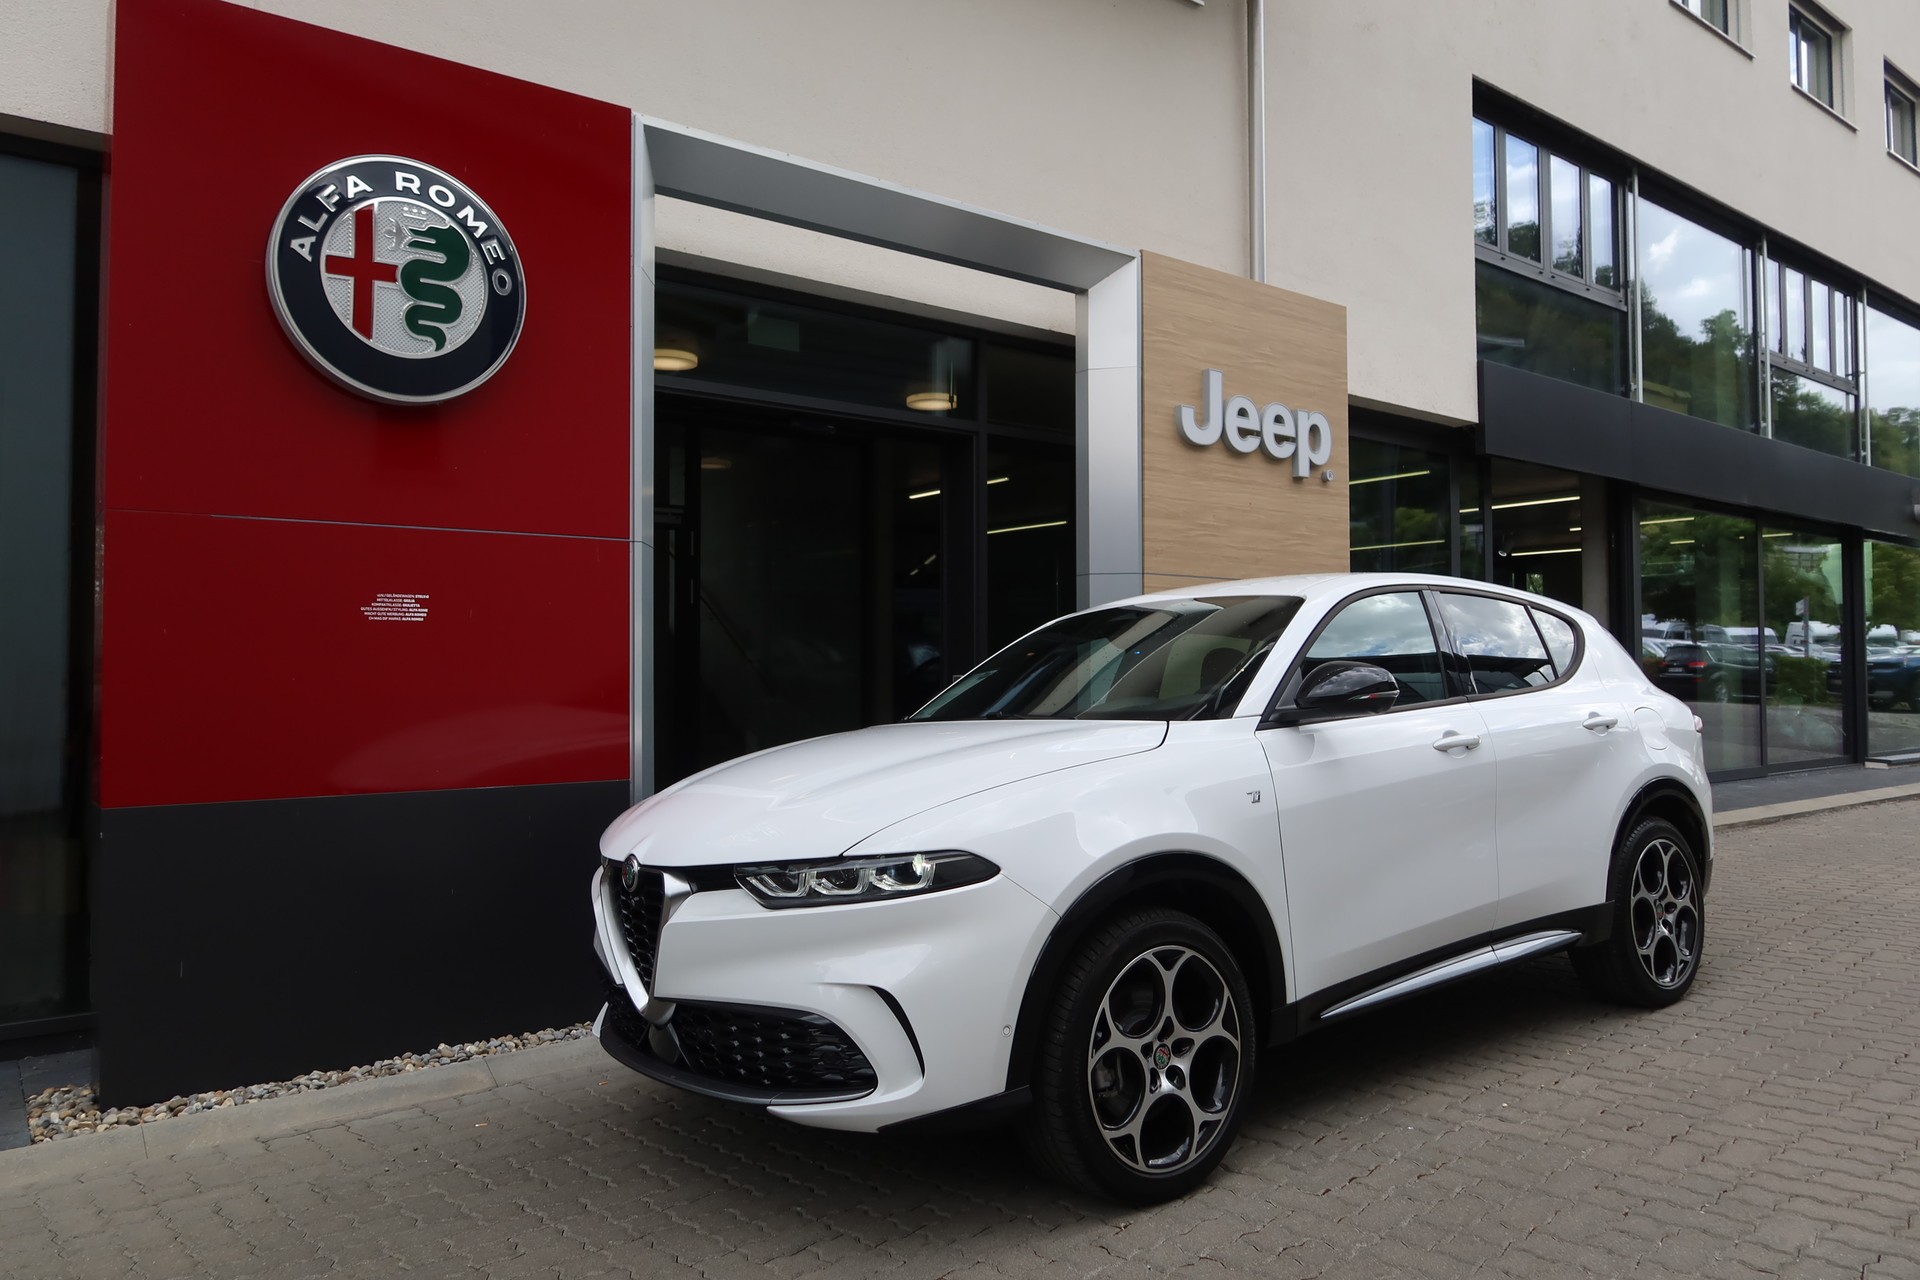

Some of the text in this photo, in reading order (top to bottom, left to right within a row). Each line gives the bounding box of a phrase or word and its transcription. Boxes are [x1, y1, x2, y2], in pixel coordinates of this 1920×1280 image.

[289, 170, 513, 296] ALFA ROMEO
[1175, 368, 1332, 480] Jeep
